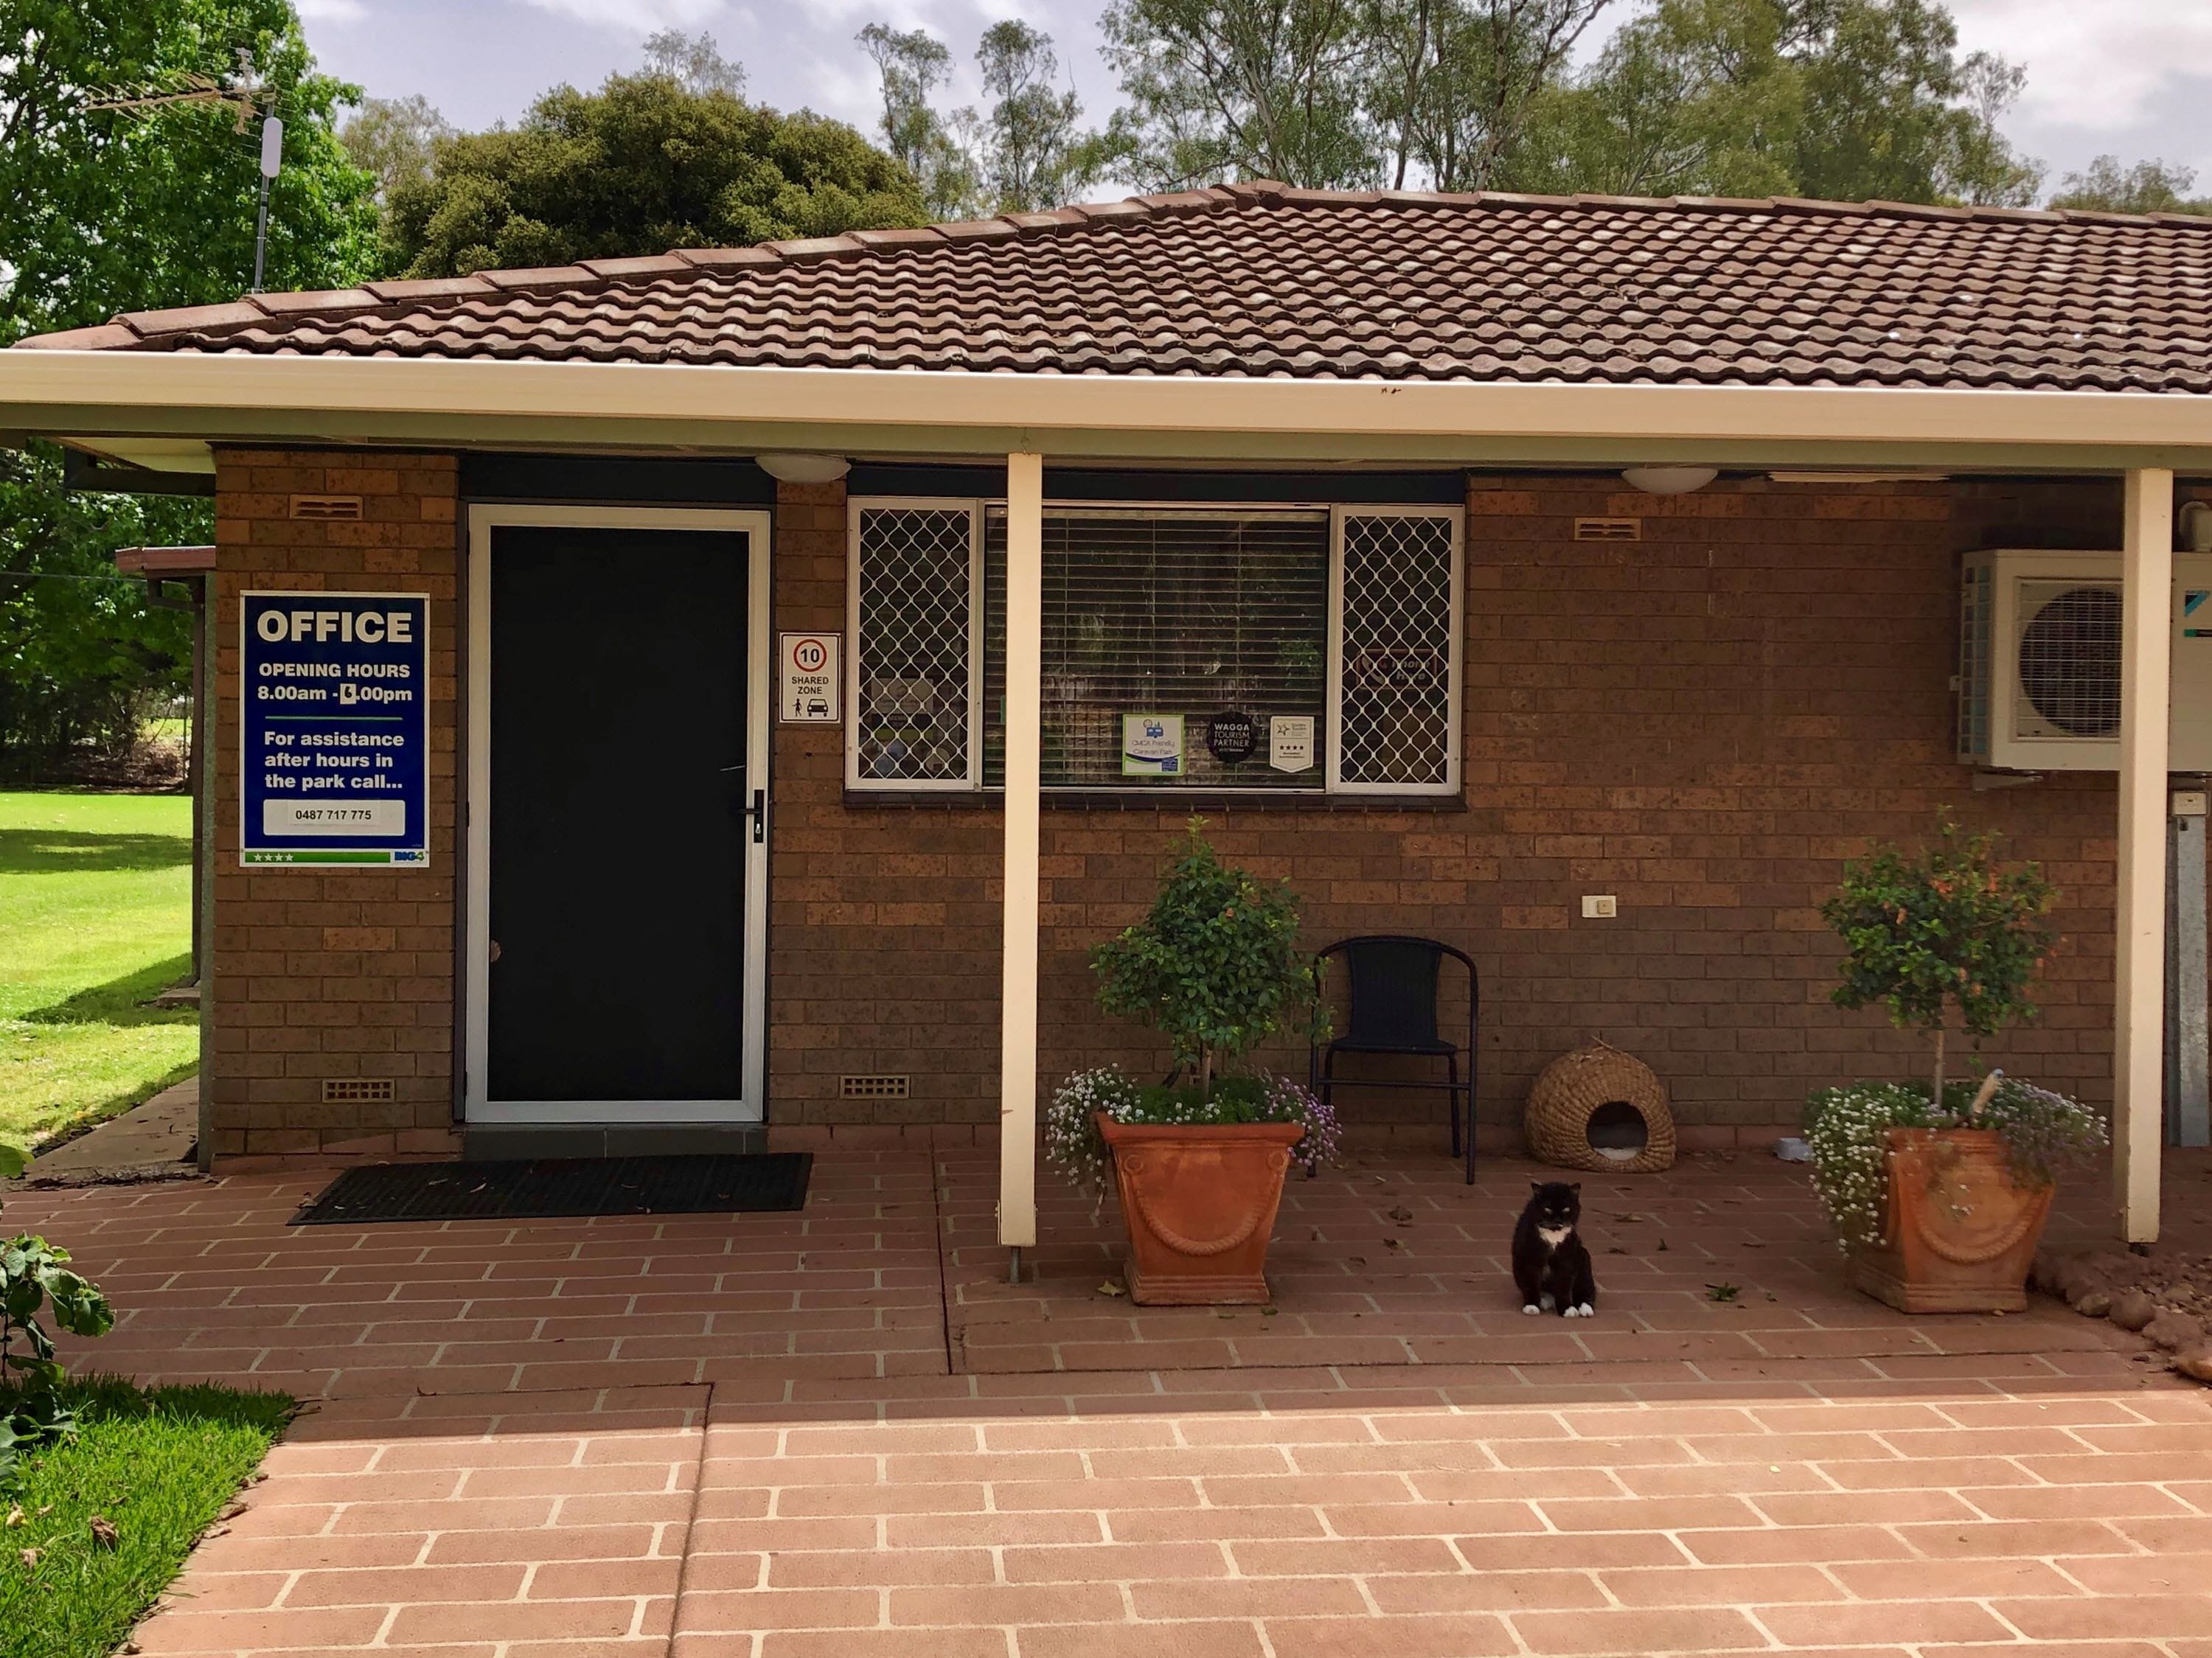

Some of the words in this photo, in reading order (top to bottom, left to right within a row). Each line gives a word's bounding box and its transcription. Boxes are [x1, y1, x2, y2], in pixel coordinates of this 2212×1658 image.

[257, 610, 412, 643] OFFICE
[800, 648, 820, 663] 10
[259, 663, 341, 678] OPENING
[347, 663, 410, 678] HOURS
[1396, 670, 1426, 680] He
[791, 676, 829, 685] SHARED
[257, 685, 327, 700] 8.00am
[797, 686, 823, 694] ZONE
[1214, 722, 1250, 731] WAGGA
[264, 731, 295, 745] For
[300, 731, 405, 746] assistance
[1214, 731, 1251, 739] TOURISM
[1213, 739, 1250, 748] PARTNER
[264, 752, 310, 767] after
[316, 753, 370, 767] hours
[375, 753, 394, 767] in
[265, 774, 296, 788] the
[302, 774, 345, 792] park
[350, 774, 403, 789] call...
[295, 809, 323, 820] 0487
[327, 810, 347, 820] 717
[350, 810, 372, 820] 775
